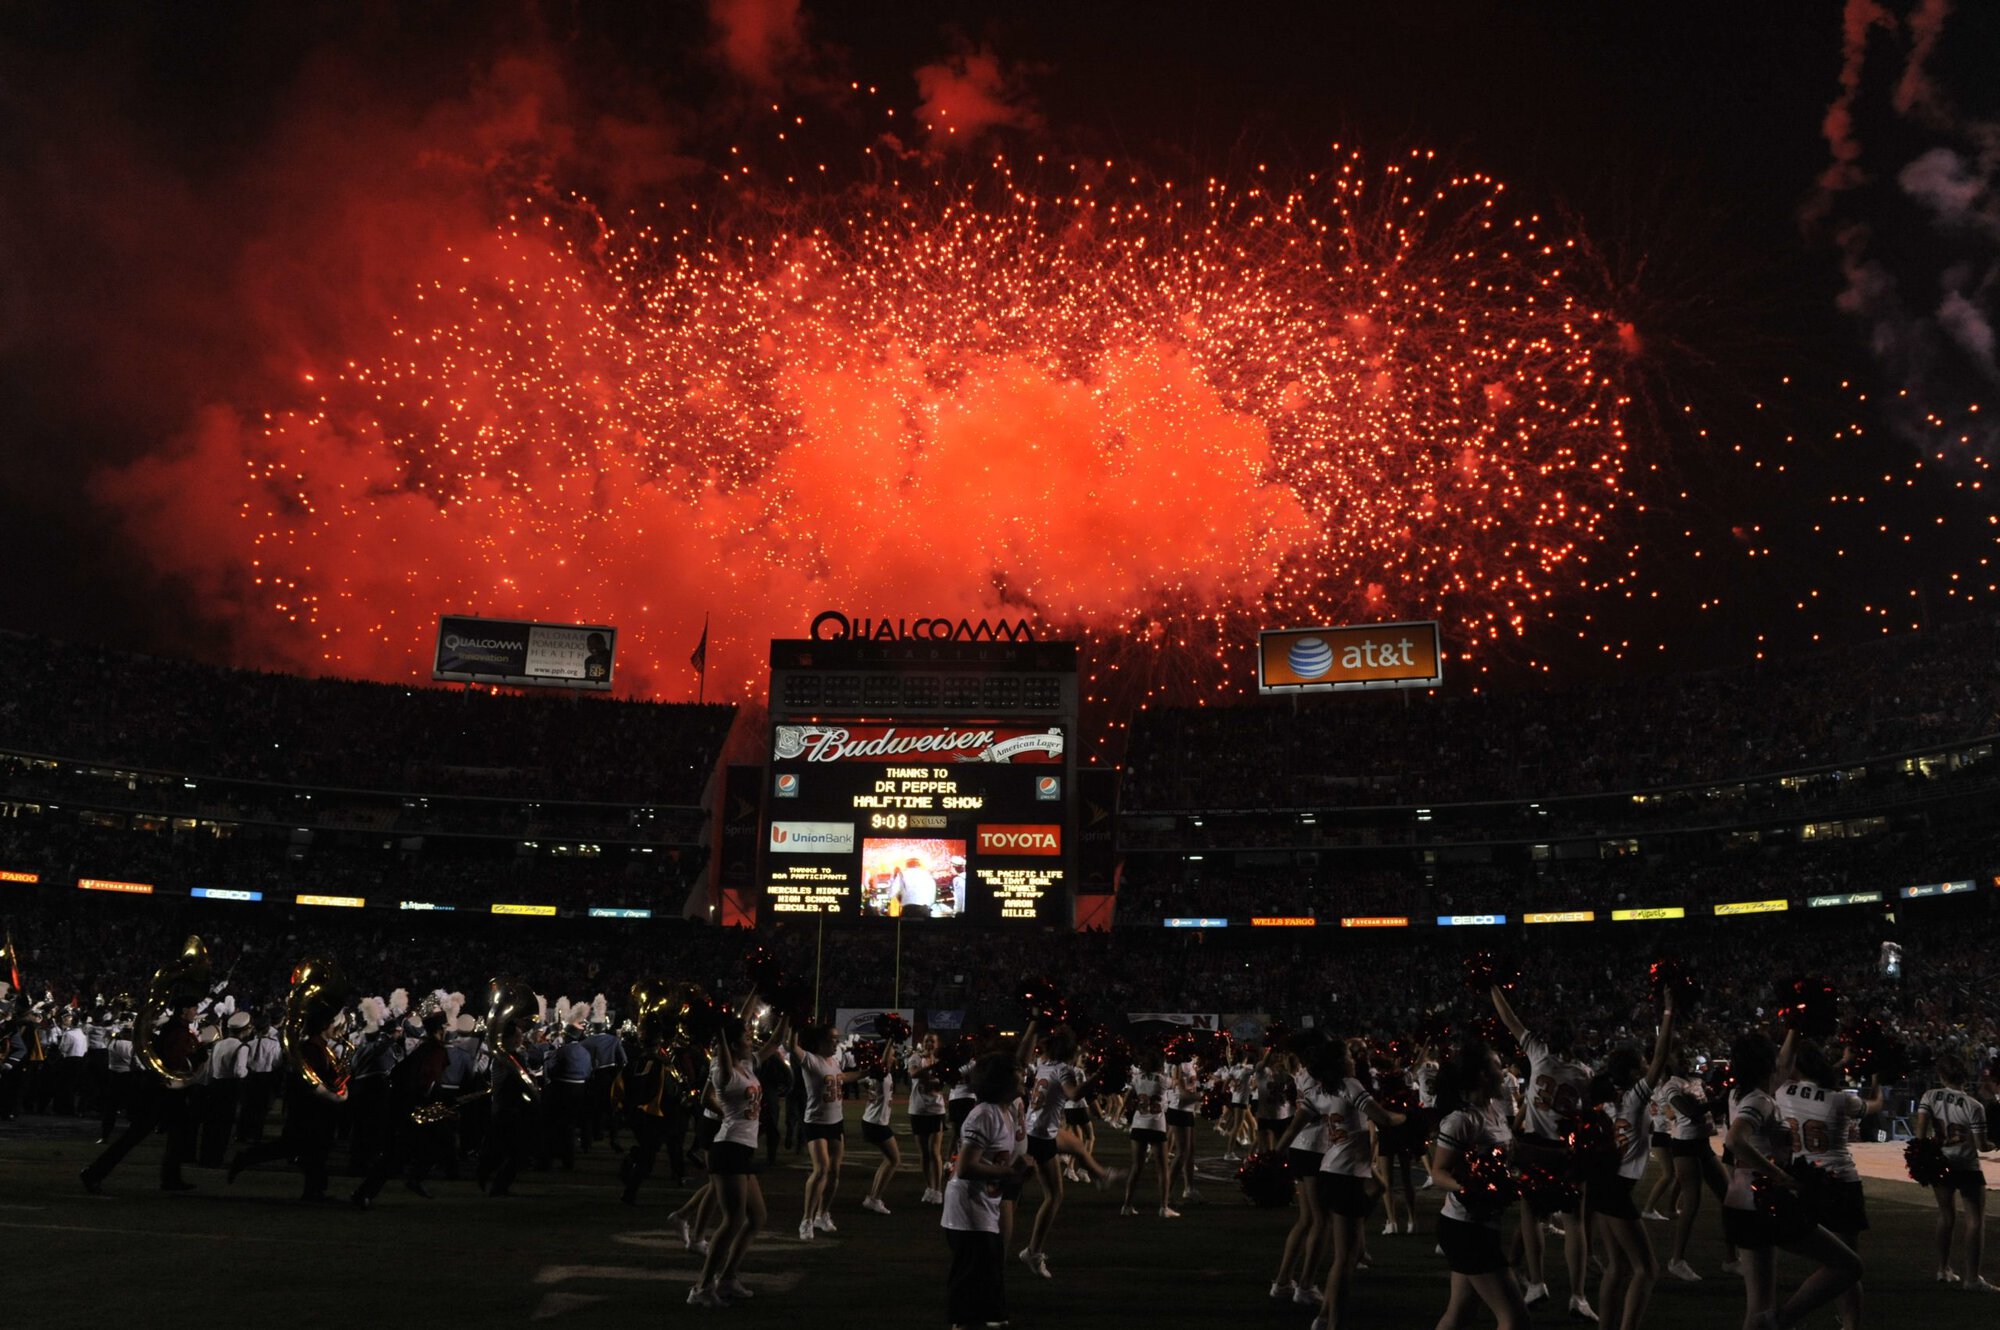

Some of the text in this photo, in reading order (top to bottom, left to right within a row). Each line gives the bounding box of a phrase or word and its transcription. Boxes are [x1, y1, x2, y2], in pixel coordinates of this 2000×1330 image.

[811, 611, 1034, 642] QUALCOMM
[533, 630, 585, 641] PALOMAR
[445, 634, 523, 651] QUALCOMM
[532, 640, 585, 651] POMERADO
[531, 649, 584, 659] HEALTH
[857, 650, 1017, 659] STADIUM
[1341, 637, 1415, 669] at&t
[534, 668, 578, 676] www.pph.org
[800, 727, 994, 762] Budweiser
[996, 739, 1061, 758] American Lager
[886, 768, 948, 778] THANKS TO
[875, 781, 957, 793] DR PEPPER
[853, 796, 983, 809] HALFTIME SHOW
[872, 814, 907, 829] 9:08
[910, 818, 947, 826] SYCUAN
[792, 833, 852, 843] UnionBank
[981, 833, 1057, 848] TOYOTA
[1, 871, 38, 884] FARGO
[997, 870, 1037, 878] PACIFIC
[1040, 871, 1063, 879] LIFE
[986, 877, 1026, 885] HOLIDAY
[767, 886, 850, 895] HERCULES MIDDLE
[303, 895, 358, 906] CYMER
[778, 895, 801, 903] HIGH
[828, 904, 840, 912] CA
[1002, 909, 1036, 917] MILLER
[1252, 918, 1315, 926] WELLS FARGO
[1451, 915, 1495, 925] GEICO
[1533, 913, 1584, 923] CYMER
[1192, 1015, 1213, 1029] N
[1786, 1084, 1825, 1102] BGA
[1935, 1091, 1964, 1107] BGA
